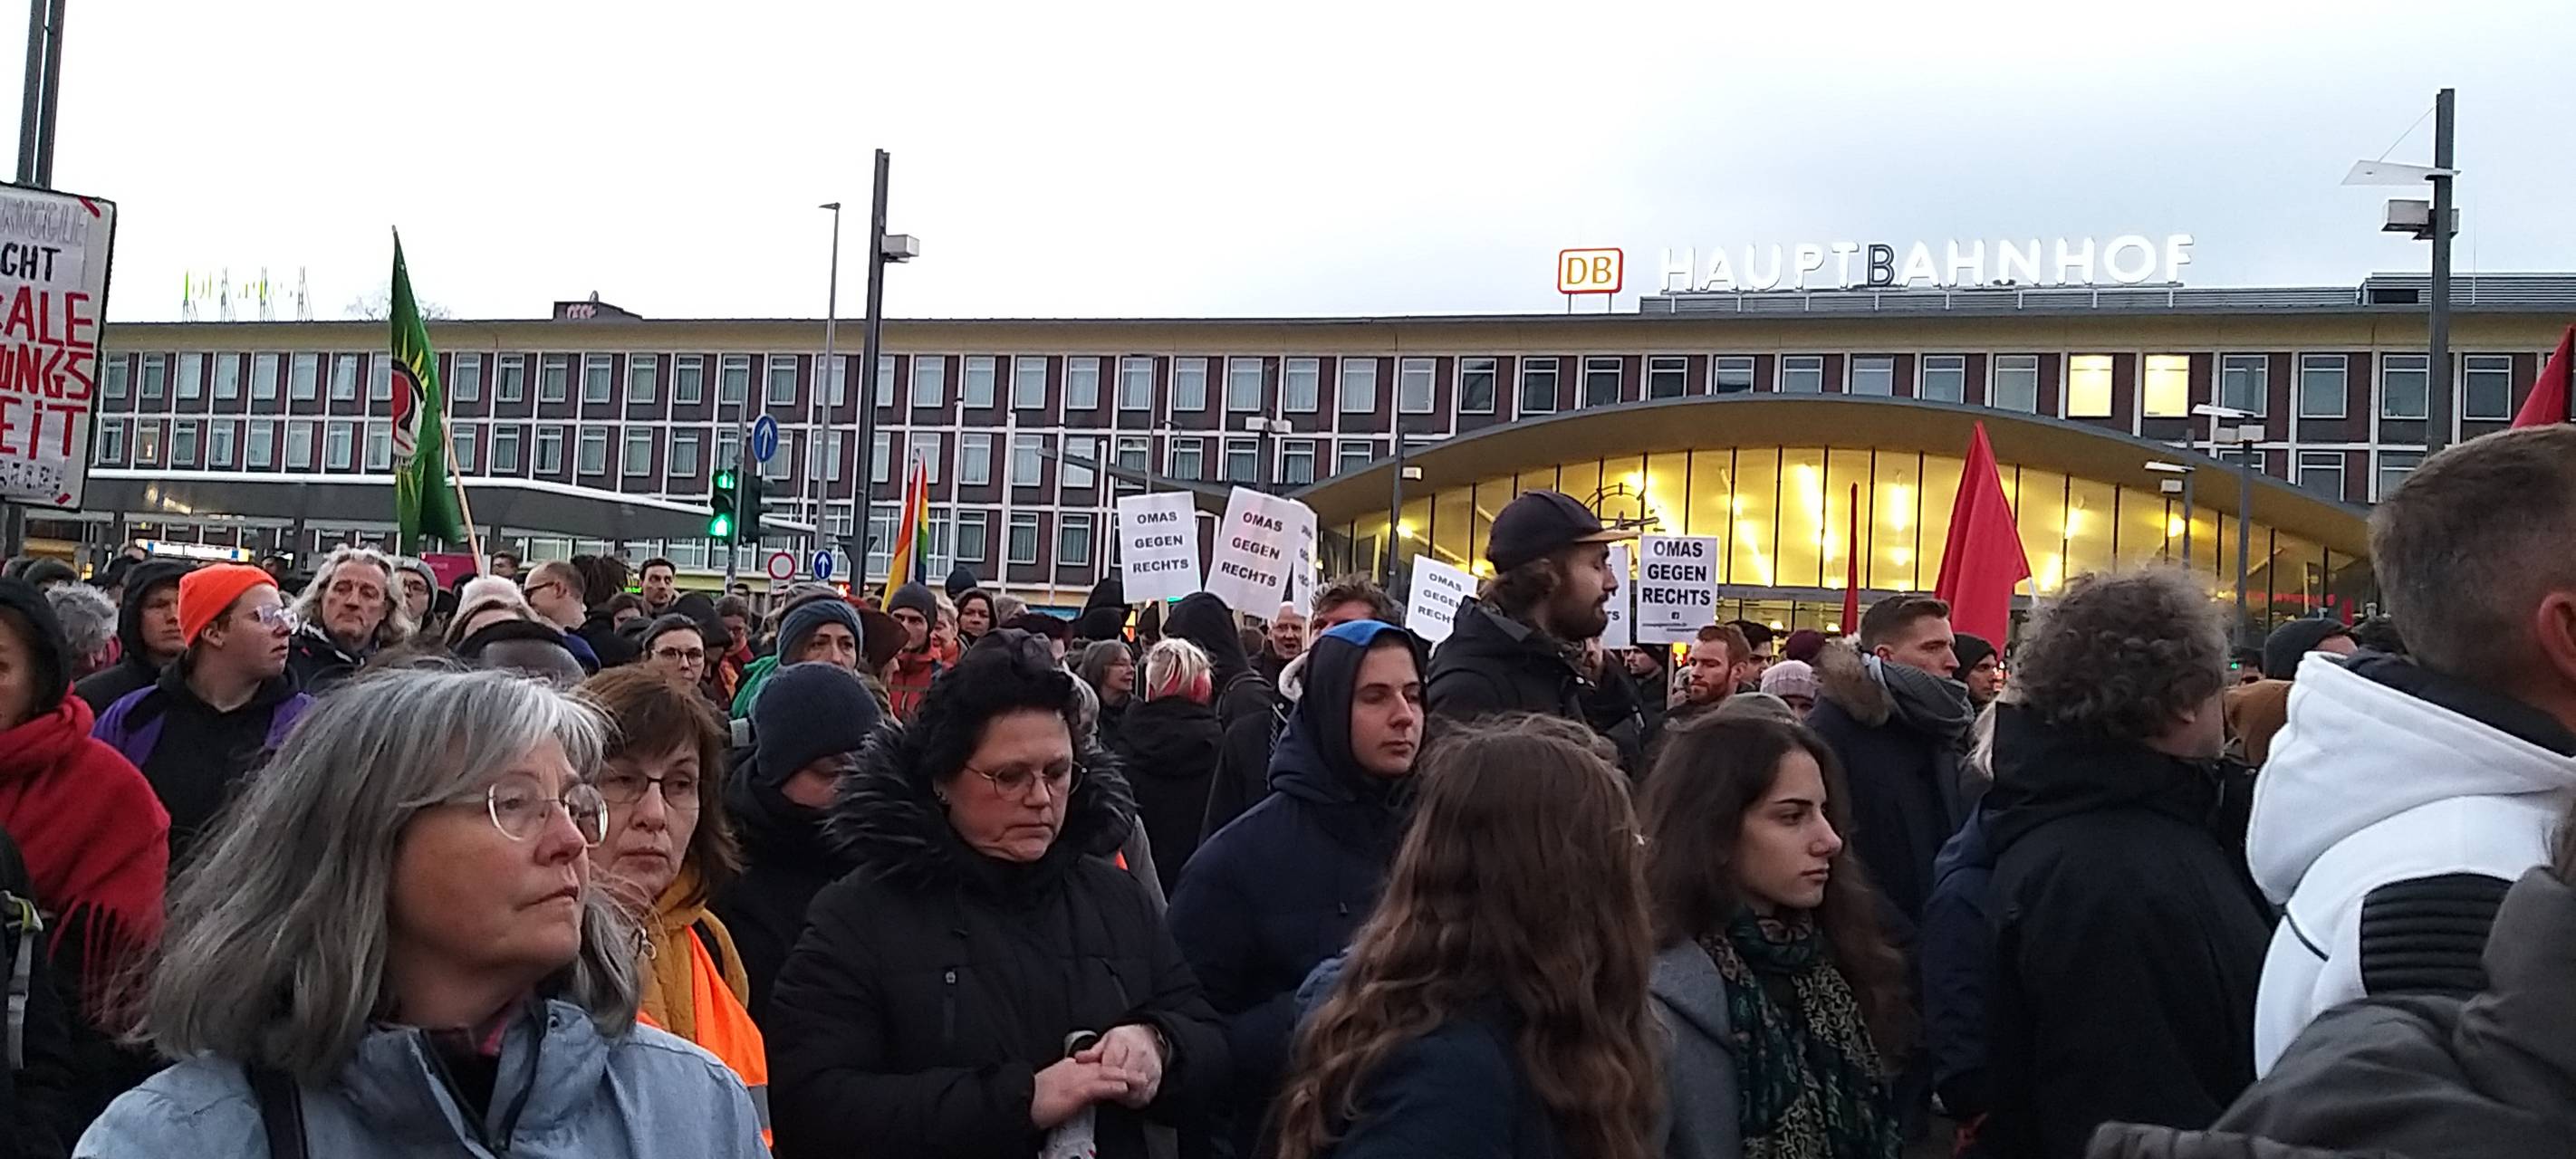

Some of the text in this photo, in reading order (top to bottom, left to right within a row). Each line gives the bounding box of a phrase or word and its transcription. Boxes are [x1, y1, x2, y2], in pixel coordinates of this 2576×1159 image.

[1566, 256, 1612, 285] DB
[1660, 235, 2195, 291] HAUPTBAHNHOF
[0, 285, 94, 350] ALE
[1137, 512, 1177, 524] OMAS
[1243, 512, 1283, 532] OMAS
[1134, 535, 1183, 549] GEGEN
[1232, 537, 1281, 560] GEGEN
[1653, 541, 1703, 558] OMAS
[1132, 559, 1189, 573] RECHTS
[1221, 561, 1277, 587] RECHTS
[1648, 563, 1706, 581] GEGEN
[1428, 572, 1462, 592] OMAS
[1642, 587, 1711, 606] RECHTS
[1418, 605, 1454, 624] RECH
